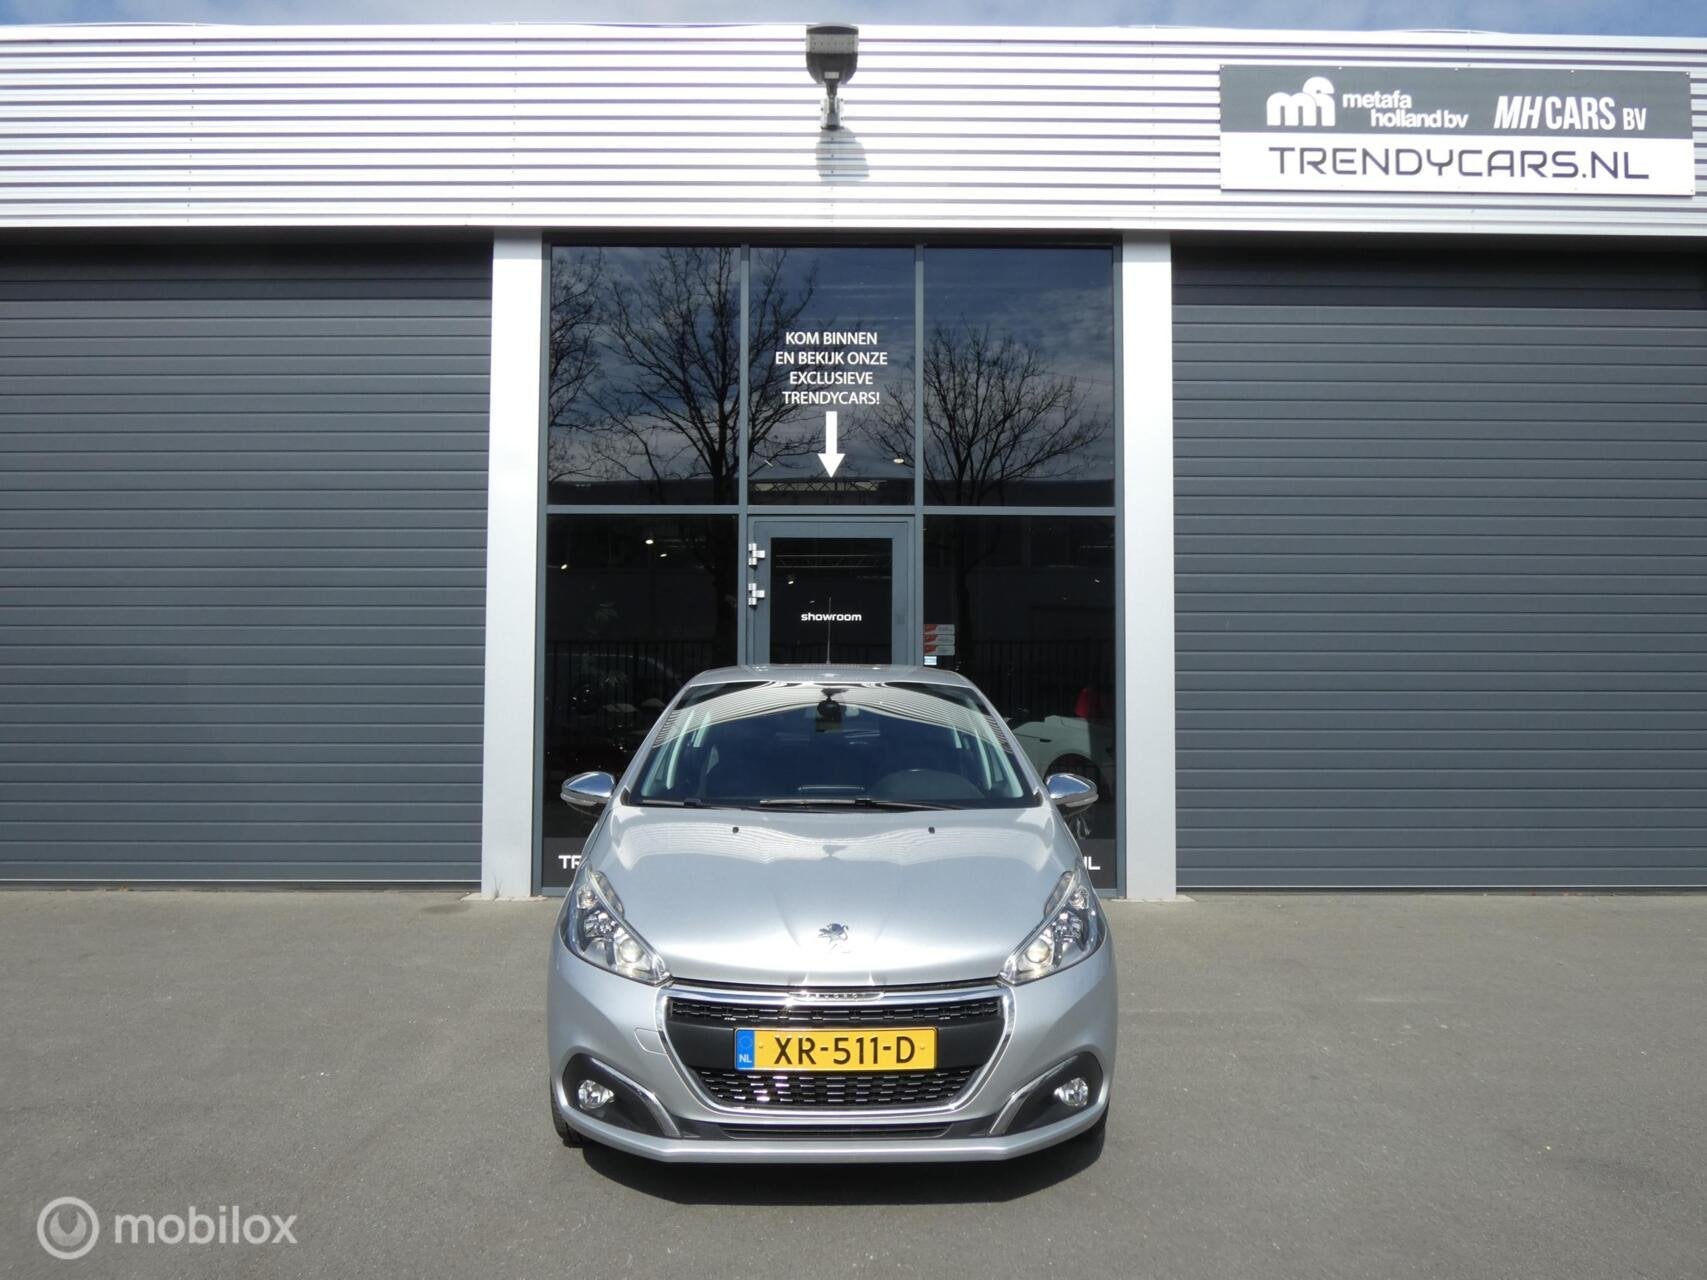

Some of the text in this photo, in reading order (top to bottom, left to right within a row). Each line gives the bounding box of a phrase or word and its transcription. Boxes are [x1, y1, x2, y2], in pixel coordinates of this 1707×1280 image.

[1342, 91, 1412, 109] metafa
[1622, 107, 1647, 131] BV
[1268, 146, 1650, 180] TRENDYCARS.NL
[785, 331, 878, 345] KOM BINNEN
[775, 351, 888, 365] EN BEKIJK ONZE
[789, 371, 874, 385] EXCLUSIEVE
[782, 391, 880, 405] TRENDYCARS!
[801, 612, 862, 622] showroom
[774, 1036, 916, 1065] XR-511-D
[738, 1054, 752, 1064] NL
